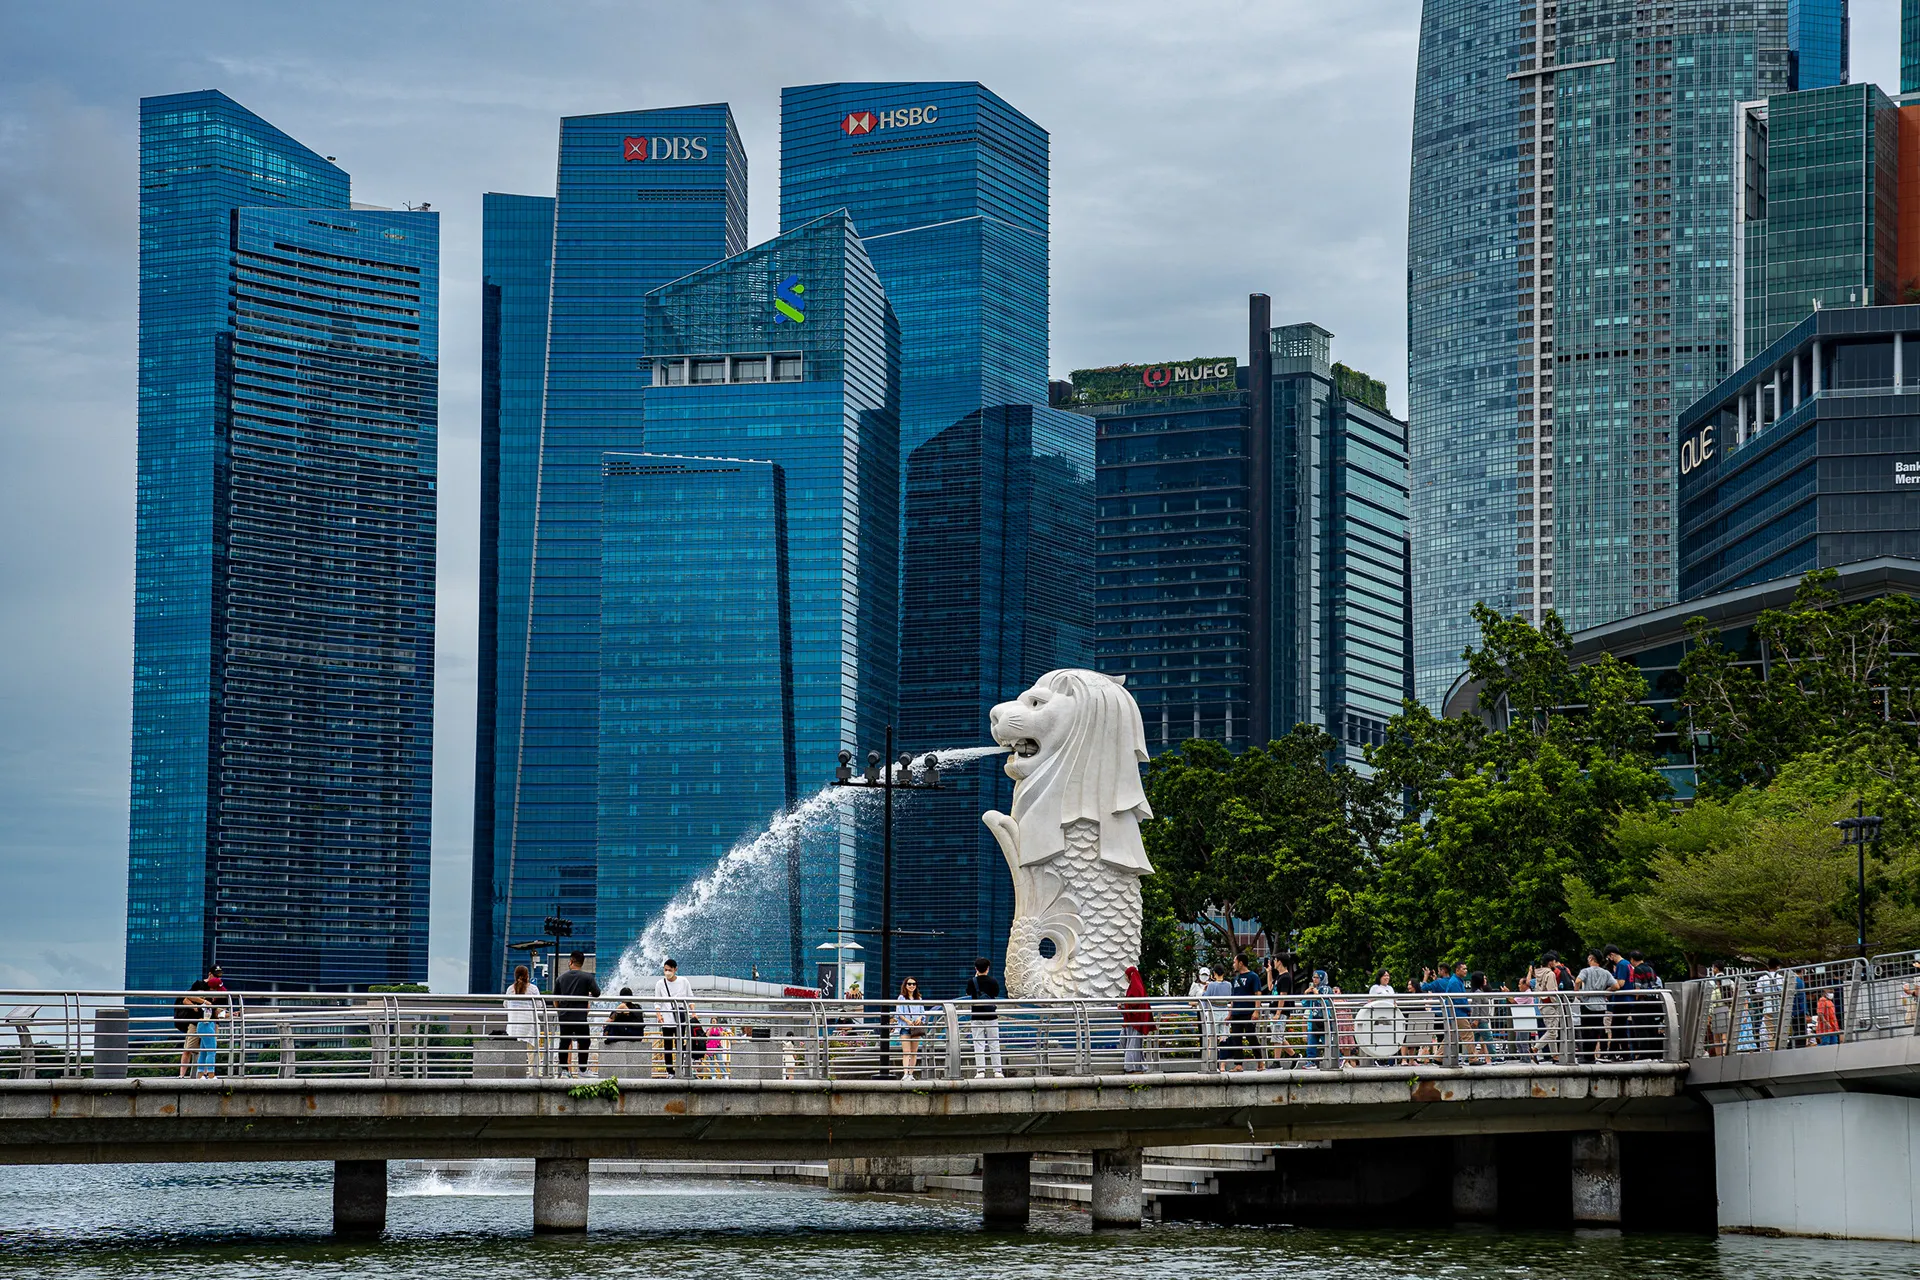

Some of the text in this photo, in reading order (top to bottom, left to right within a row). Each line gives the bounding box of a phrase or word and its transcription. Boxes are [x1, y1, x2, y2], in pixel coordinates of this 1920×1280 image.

[879, 105, 938, 130] HSBC
[651, 136, 708, 160] DBS
[1174, 362, 1228, 382] MUFG
[1681, 425, 1714, 475] OUE
